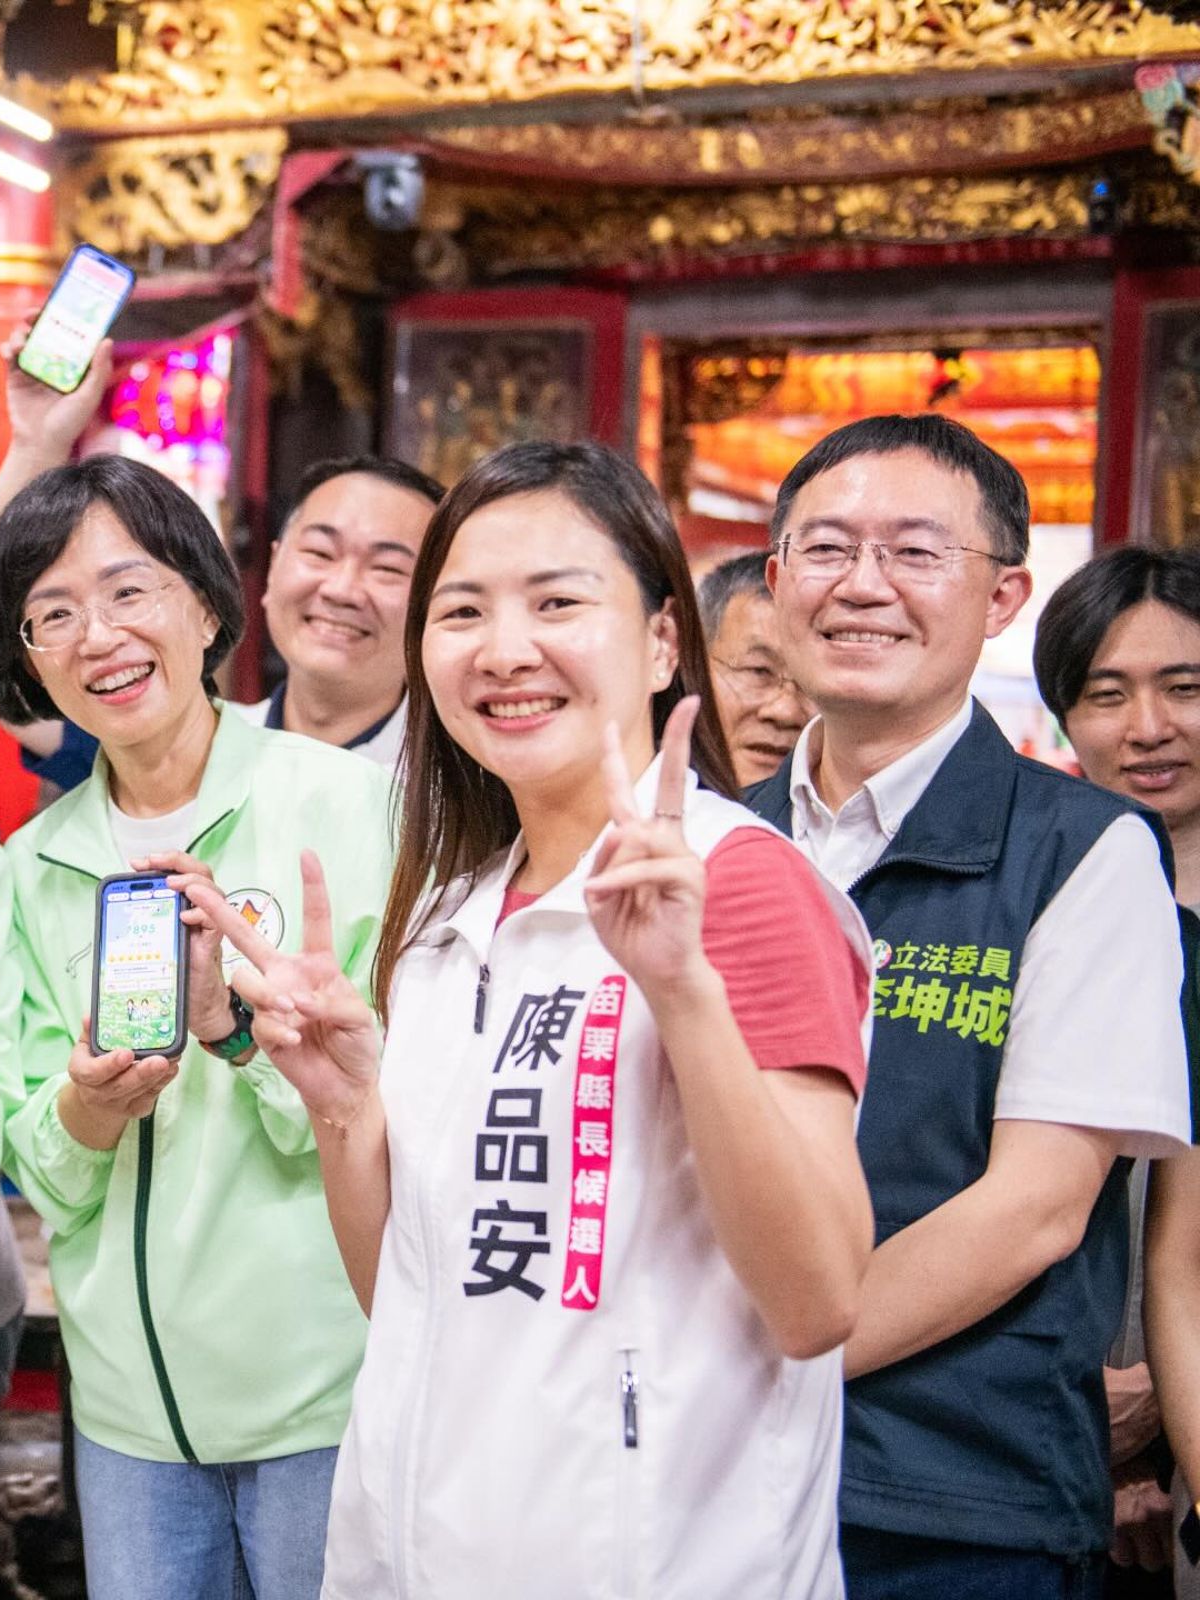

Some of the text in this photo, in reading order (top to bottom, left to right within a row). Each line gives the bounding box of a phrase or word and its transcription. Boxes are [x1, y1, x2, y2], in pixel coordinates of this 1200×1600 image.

[889, 940, 1012, 982] 立法委員
[463, 984, 586, 1302] 陳品安
[563, 980, 624, 1304] 苗栗縣長候選人
